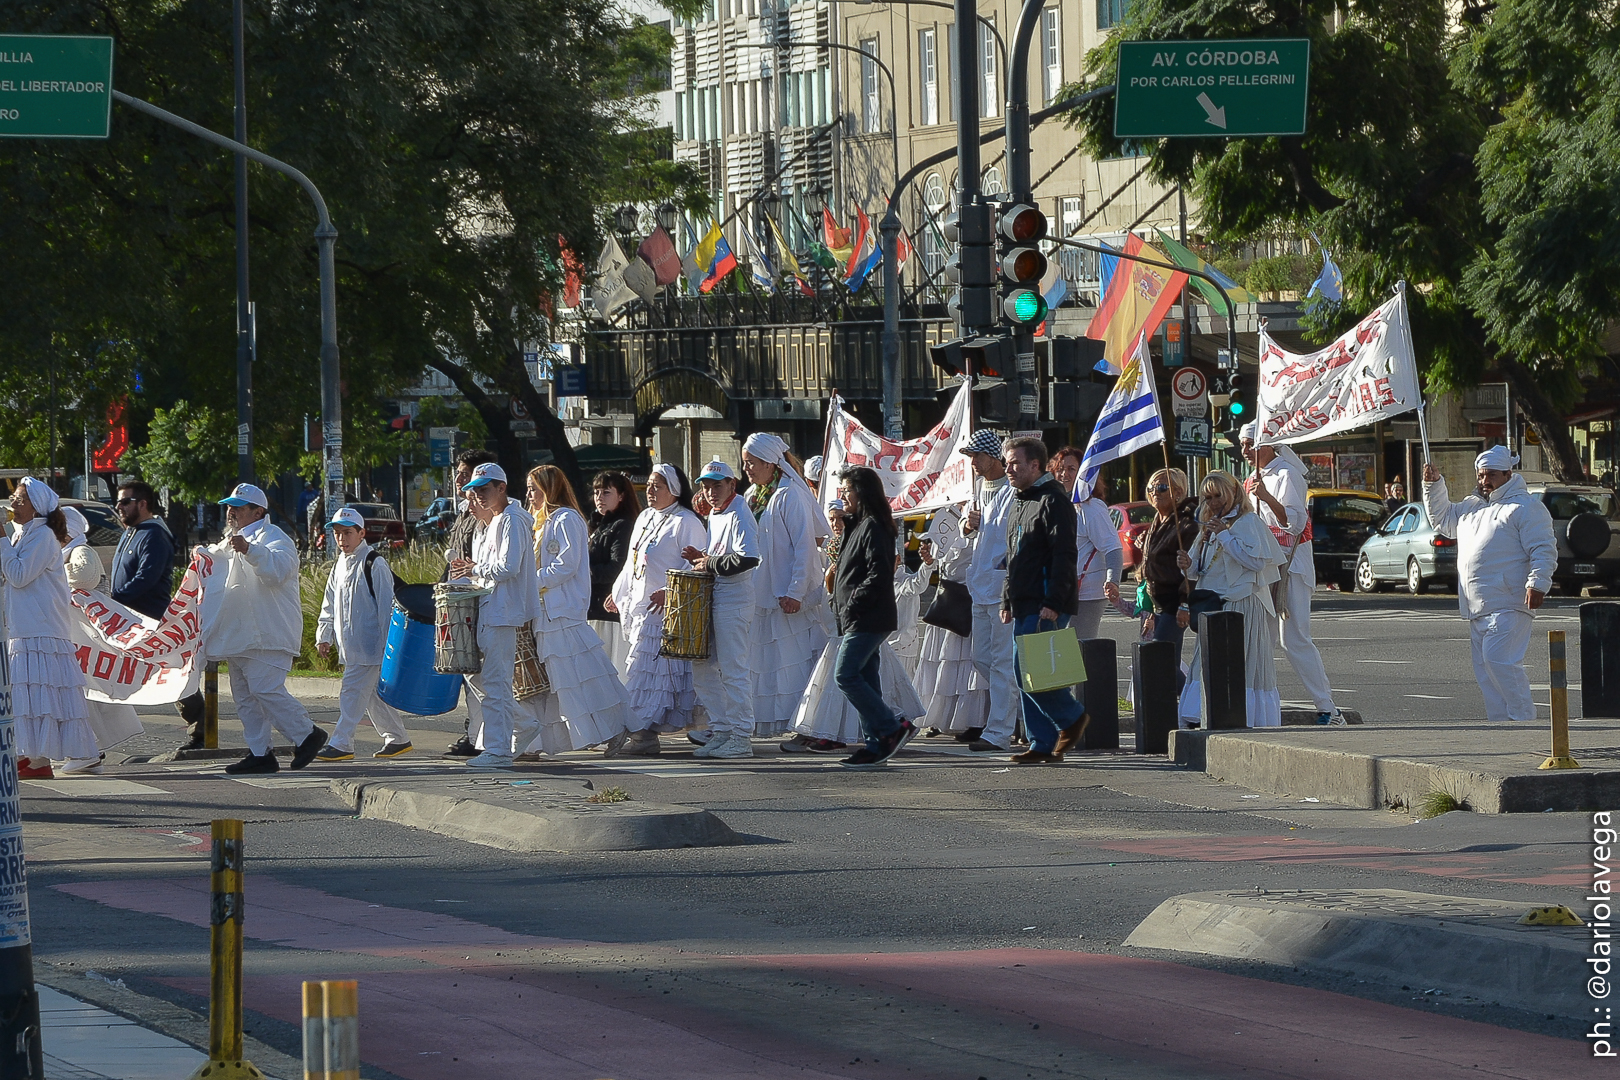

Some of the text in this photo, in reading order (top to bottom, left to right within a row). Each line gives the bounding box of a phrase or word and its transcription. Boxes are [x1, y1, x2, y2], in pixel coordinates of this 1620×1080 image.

[1151, 48, 1280, 67] AV. CÓRDOBA
[21, 81, 105, 93] LIBERTADOR
[1130, 74, 1295, 87] POR CARLOS PELLEGRINI
[562, 370, 580, 391] E
